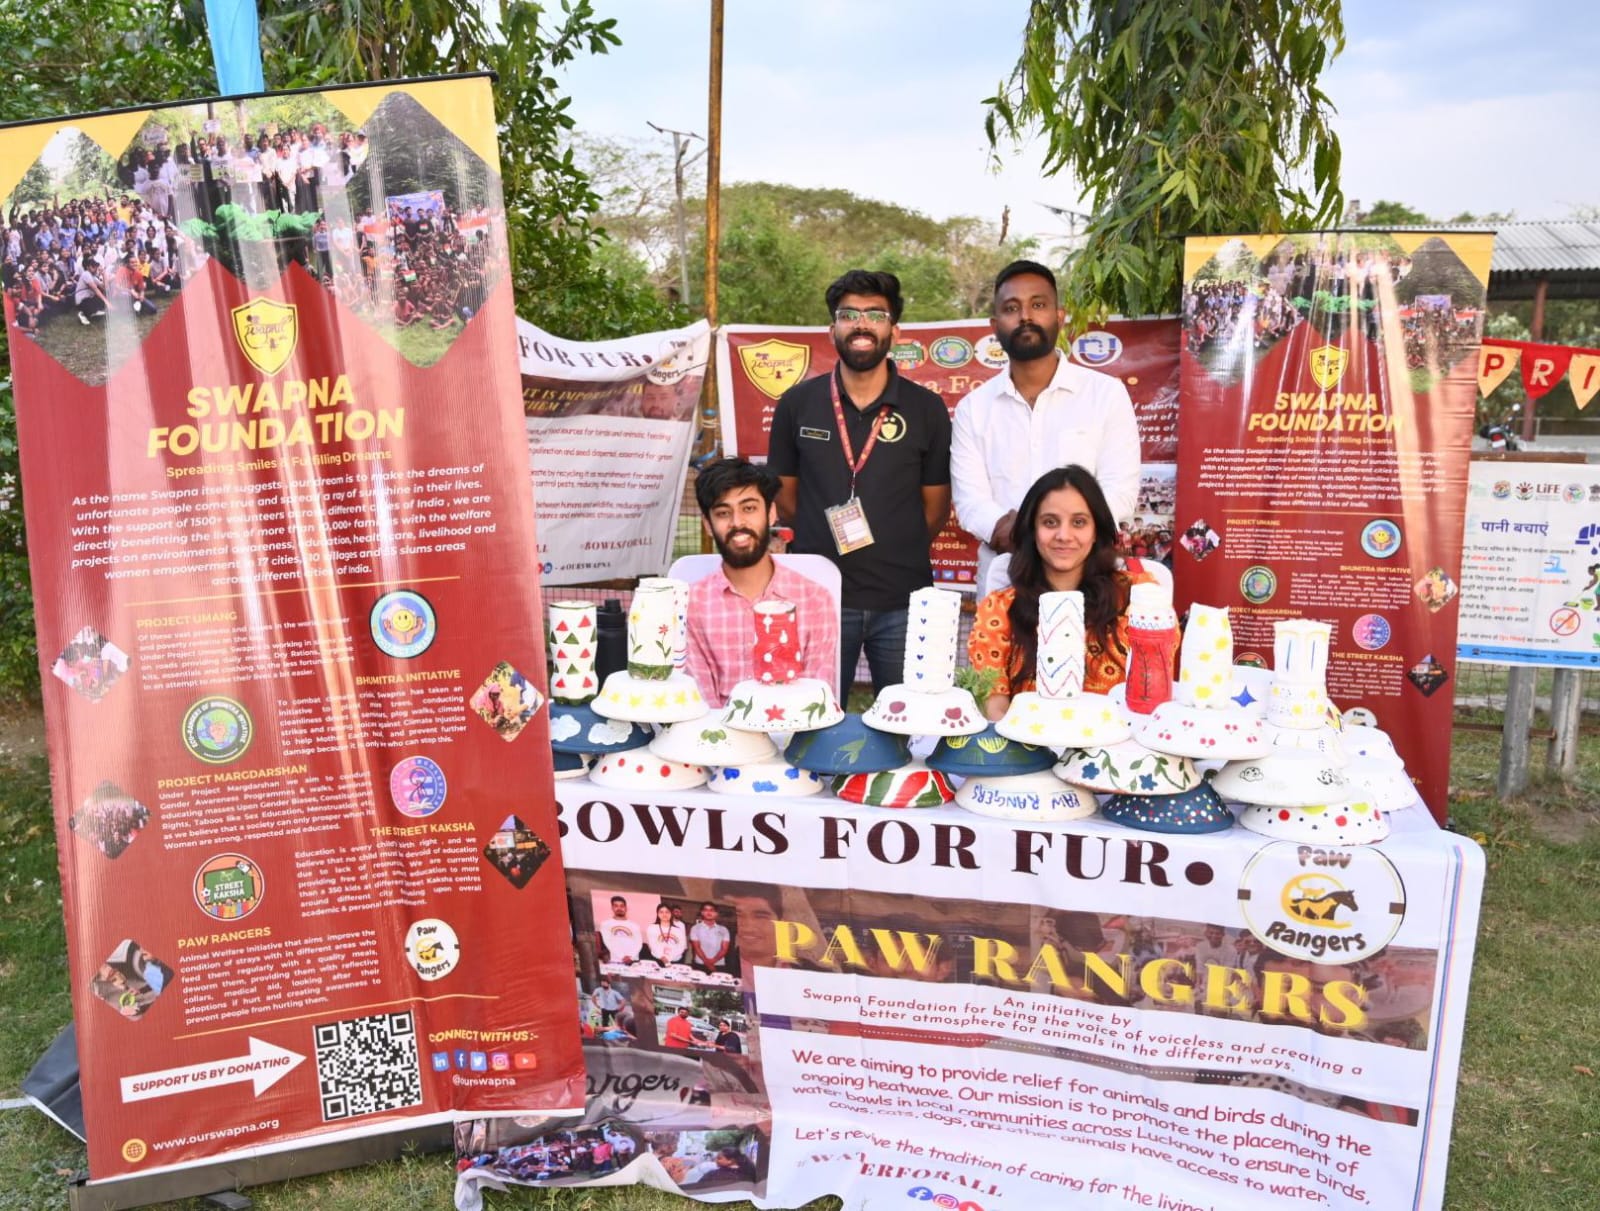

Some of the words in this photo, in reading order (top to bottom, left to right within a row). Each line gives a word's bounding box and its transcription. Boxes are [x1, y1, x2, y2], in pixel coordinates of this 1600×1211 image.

[519, 335, 575, 368] FOR
[187, 374, 355, 418] SWAPNA
[1275, 393, 1378, 411] SWAPNA
[148, 408, 405, 458] FOUNDATION
[1248, 413, 1404, 432] FOUNDATION
[1257, 436, 1294, 445] Spreading
[1363, 437, 1392, 445] Dreams
[167, 461, 233, 478] Spreading
[237, 459, 277, 472] Smiles
[293, 454, 341, 467] Fulfilling
[343, 449, 392, 461] Dreams
[72, 497, 86, 506] As
[90, 494, 109, 504] the
[113, 492, 148, 502] name
[151, 488, 198, 500] Swapna
[1536, 484, 1560, 494] LiFE
[402, 514, 426, 525] with
[429, 512, 447, 523] the
[450, 509, 491, 520] welfare
[1481, 519, 1510, 533] पानी
[1514, 522, 1549, 536] बचाएं
[419, 526, 471, 538] livelihood
[474, 524, 496, 533] and
[1340, 565, 1374, 573] BHUMITRA
[1374, 566, 1411, 574] INITIATIVE
[137, 616, 191, 629] PROJECT
[193, 611, 238, 623] UMANG
[1250, 607, 1302, 616] MARGDARSHAN
[406, 669, 461, 682] INITIATIVE
[158, 775, 211, 789] PROJECT
[214, 765, 308, 782] MARGDARSHAN
[972, 783, 1041, 811] RANGERS
[370, 827, 393, 838] THE
[431, 822, 475, 833] KAKSHA
[819, 816, 981, 869] FOR
[1012, 830, 1214, 887] FUR.
[1297, 845, 1353, 868] Paw
[213, 888, 245, 900] KAKSHA
[214, 880, 244, 893] STREET
[178, 936, 209, 949] PAW
[211, 927, 272, 944] RANGERS
[417, 925, 437, 936] Paw
[1265, 921, 1367, 957] Rangers
[180, 953, 209, 963] Animal
[212, 948, 244, 959] Welfare
[246, 943, 282, 953] Initiative
[183, 983, 218, 994] deworm
[222, 978, 247, 988] them,
[251, 972, 290, 984] providing
[294, 967, 315, 976] them
[319, 963, 338, 972] with
[342, 959, 379, 969] reflective
[772, 920, 943, 973] PAW
[968, 935, 1369, 1028] RANGERS
[1004, 997, 1025, 1009] An
[1032, 1001, 1105, 1023] initiative
[1111, 1013, 1132, 1028] by
[429, 1028, 478, 1042] CONNECT
[480, 1031, 511, 1042] WITH
[513, 1030, 529, 1041] US
[803, 988, 861, 1005] Swapna
[868, 995, 957, 1013] Foundation
[964, 1003, 987, 1014] for
[993, 1005, 1037, 1024] being
[1045, 1014, 1070, 1027] the
[1077, 1021, 1118, 1037] voice
[1125, 1030, 1142, 1042] of
[1149, 1034, 1224, 1049] voiceless
[1231, 1042, 1265, 1055] and
[1271, 1047, 1343, 1075] creating
[1351, 1065, 1363, 1075] a
[859, 1006, 907, 1020] better
[912, 1013, 1005, 1029] atmosphere
[1012, 1021, 1036, 1033] for
[1042, 1028, 1105, 1047] animals
[1111, 1040, 1125, 1050] in
[1133, 1044, 1160, 1058] the
[1166, 1047, 1245, 1065] different
[1250, 1058, 1295, 1072] ways.
[132, 1074, 189, 1093] SUPPORT
[192, 1071, 207, 1082] US
[210, 1068, 225, 1079] BY
[227, 1056, 290, 1075] DONATING
[792, 1048, 823, 1065] We
[827, 1053, 856, 1067] are
[860, 1059, 913, 1079] aiming
[918, 1064, 937, 1078] to
[942, 1066, 1009, 1082] provide
[1013, 1073, 1062, 1091] relief
[1068, 1076, 1098, 1094] for
[1103, 1087, 1169, 1113] animals
[1174, 1103, 1209, 1122] and
[1214, 1106, 1265, 1125] birds
[1270, 1115, 1331, 1147] during
[1336, 1133, 1373, 1157] the
[153, 1119, 280, 1151] www.ourswapna.org
[801, 1072, 864, 1090] ongoing
[868, 1075, 953, 1100] heatwave.
[958, 1086, 994, 1102] Our
[998, 1091, 1063, 1112] mission
[1068, 1096, 1083, 1112] is
[1086, 1103, 1108, 1116] to
[1112, 1108, 1189, 1135] promote
[1194, 1127, 1228, 1145] the
[1233, 1131, 1331, 1167] placement
[1336, 1159, 1359, 1177] of
[792, 1085, 842, 1097] water
[845, 1090, 892, 1107] bowls
[897, 1097, 912, 1107] in
[916, 1099, 953, 1112] local
[959, 1105, 1068, 1131] communities
[1072, 1120, 1133, 1138] across
[1136, 1125, 1215, 1160] Lucknow
[1219, 1151, 1240, 1167] to
[1244, 1156, 1311, 1179] ensure
[1315, 1168, 1371, 1205] birds,
[795, 1127, 840, 1141] Let's
[845, 1128, 891, 1149] revive
[896, 1140, 924, 1156] the
[928, 1146, 1002, 1172] tradition
[1006, 1163, 1027, 1177] of
[1030, 1168, 1084, 1191] caring
[1089, 1178, 1119, 1194] for
[1122, 1184, 1153, 1206] the
[922, 1110, 968, 1129] dogs,
[971, 1119, 1002, 1131] and
[1061, 1132, 1126, 1153] animals
[1131, 1141, 1172, 1163] have
[1176, 1156, 1239, 1185] access
[1244, 1178, 1264, 1192] to
[1269, 1182, 1331, 1208] water.
